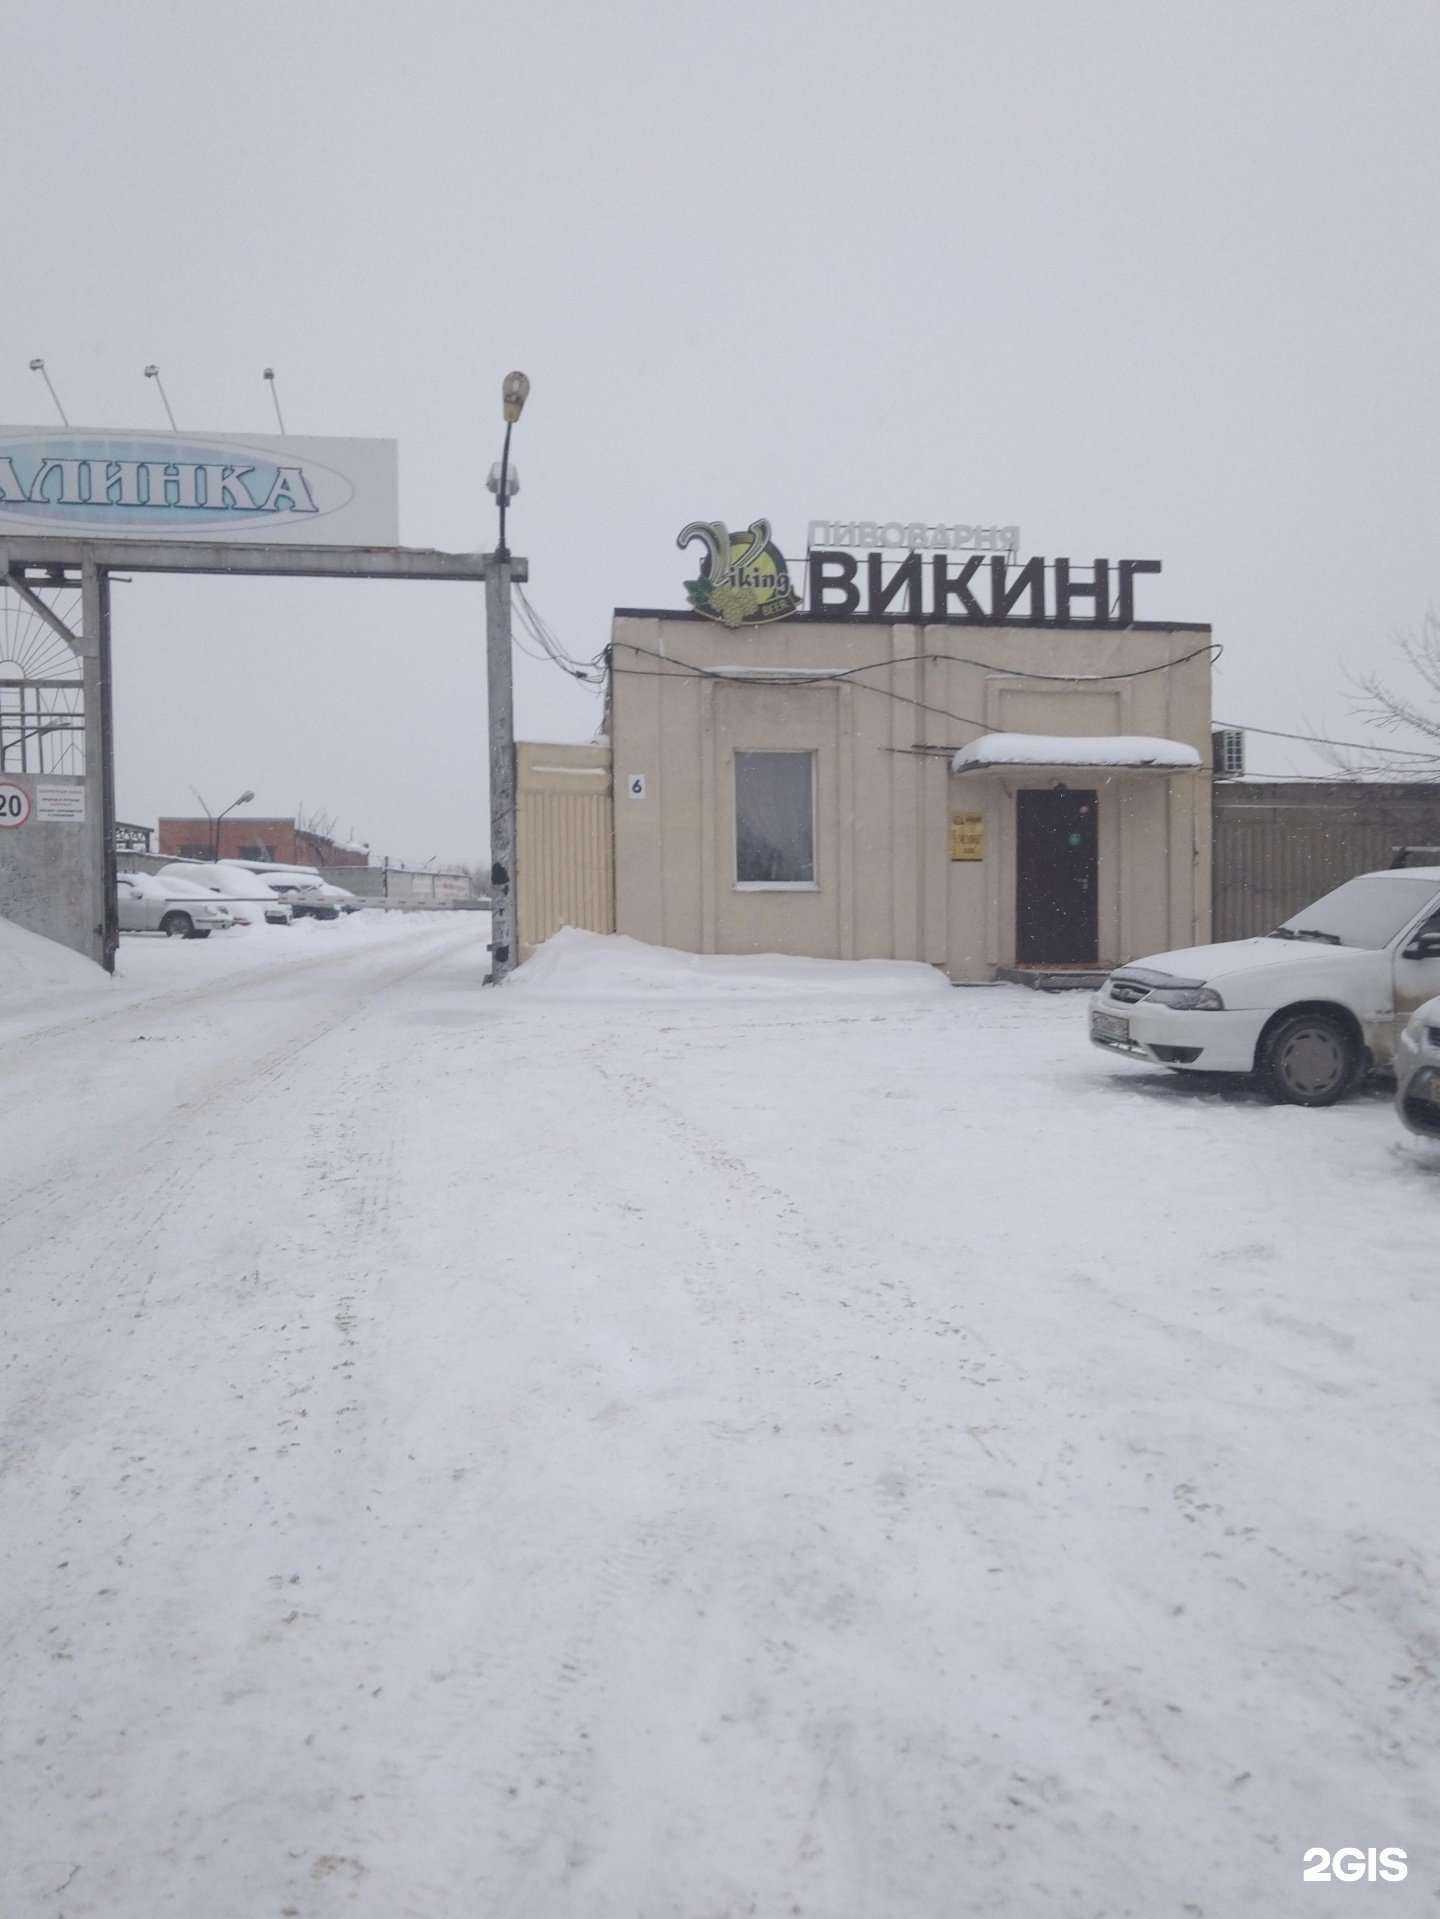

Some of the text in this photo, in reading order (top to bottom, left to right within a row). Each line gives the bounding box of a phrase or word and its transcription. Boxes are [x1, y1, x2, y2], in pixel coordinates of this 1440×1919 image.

[808, 520, 1020, 551] ПИВОВАРНЯ
[677, 519, 790, 598] Viking
[810, 551, 1161, 621] ВИКИНГ
[632, 779, 642, 793] 6
[0, 794, 21, 817] 20
